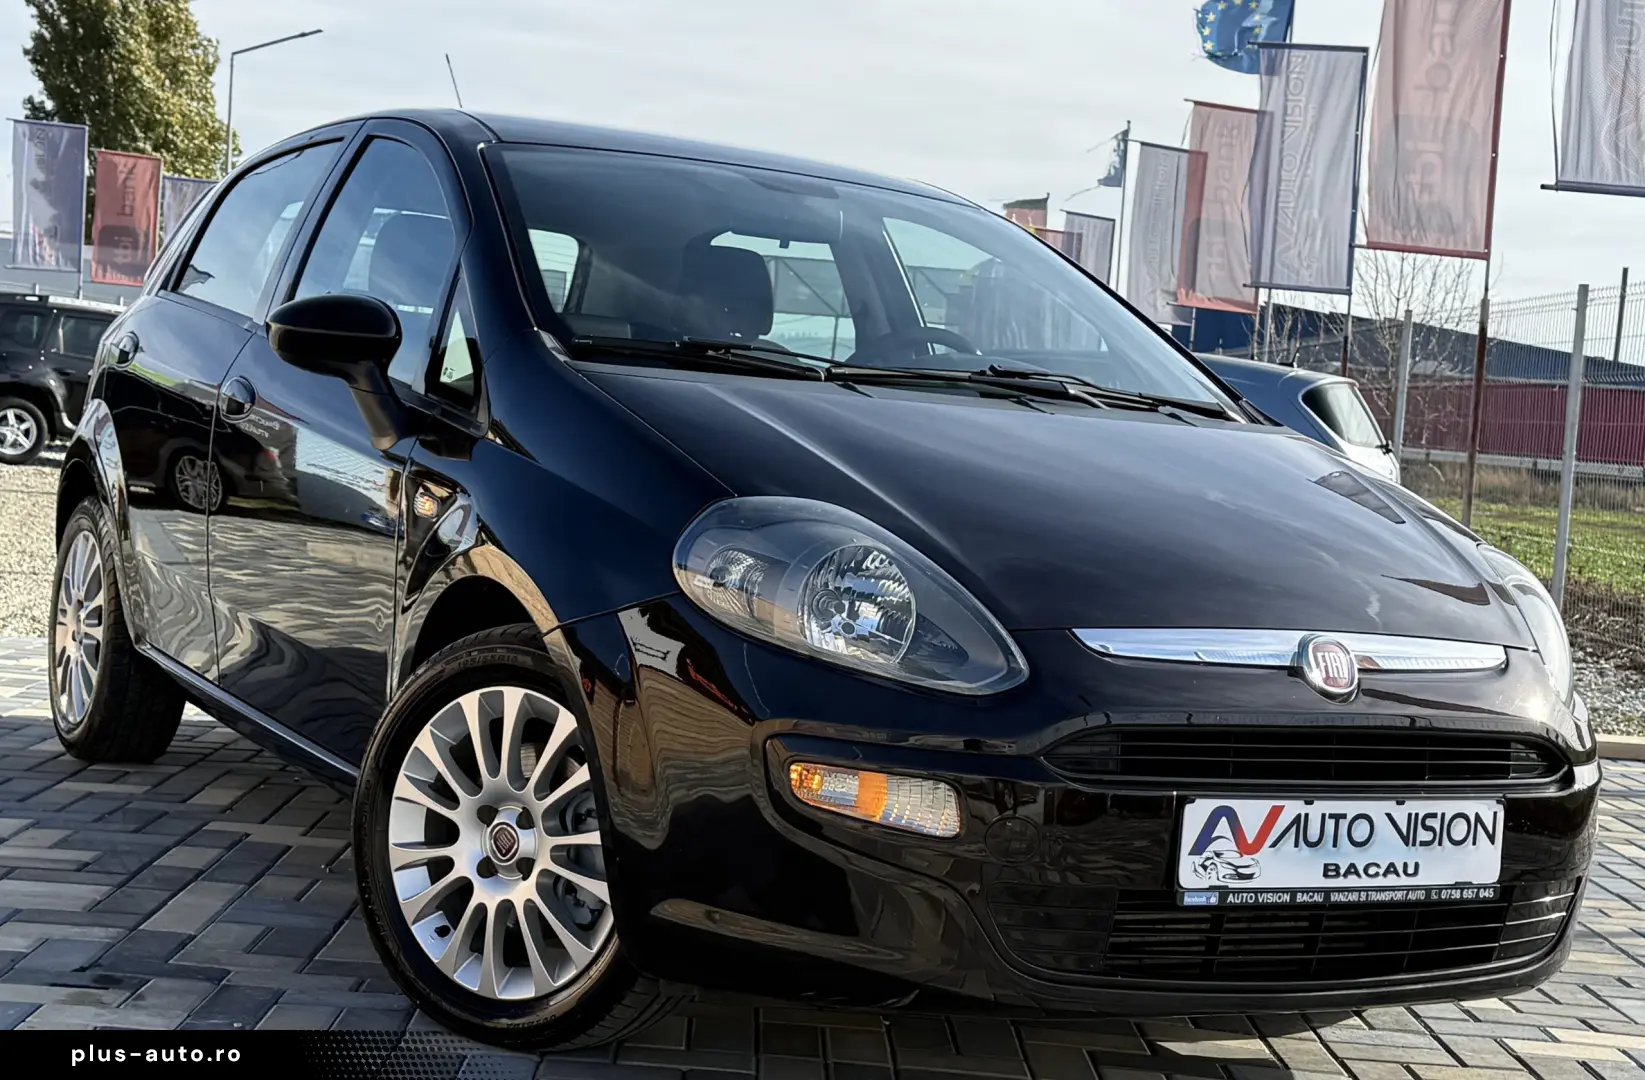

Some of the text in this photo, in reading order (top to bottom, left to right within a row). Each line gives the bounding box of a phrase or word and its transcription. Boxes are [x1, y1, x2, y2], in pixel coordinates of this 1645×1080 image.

[1282, 53, 1309, 142] VISION
[1276, 151, 1298, 228] AUTO
[113, 160, 138, 265] tbi bank
[1316, 651, 1348, 679] FIAT
[1268, 812, 1375, 849] AUTO
[1384, 811, 1498, 848] VISION
[1322, 861, 1420, 879] BACAU
[1226, 892, 1256, 904] AUTO
[1257, 892, 1291, 904] VISION
[1296, 891, 1325, 903] BACAU
[1330, 890, 1359, 903] VANZARI
[1367, 889, 1407, 902] TRANSPORT
[1407, 889, 1426, 901] AUTO
[1441, 888, 1461, 900] 0758
[1462, 888, 1478, 899] 657
[1479, 887, 1495, 899] 045
